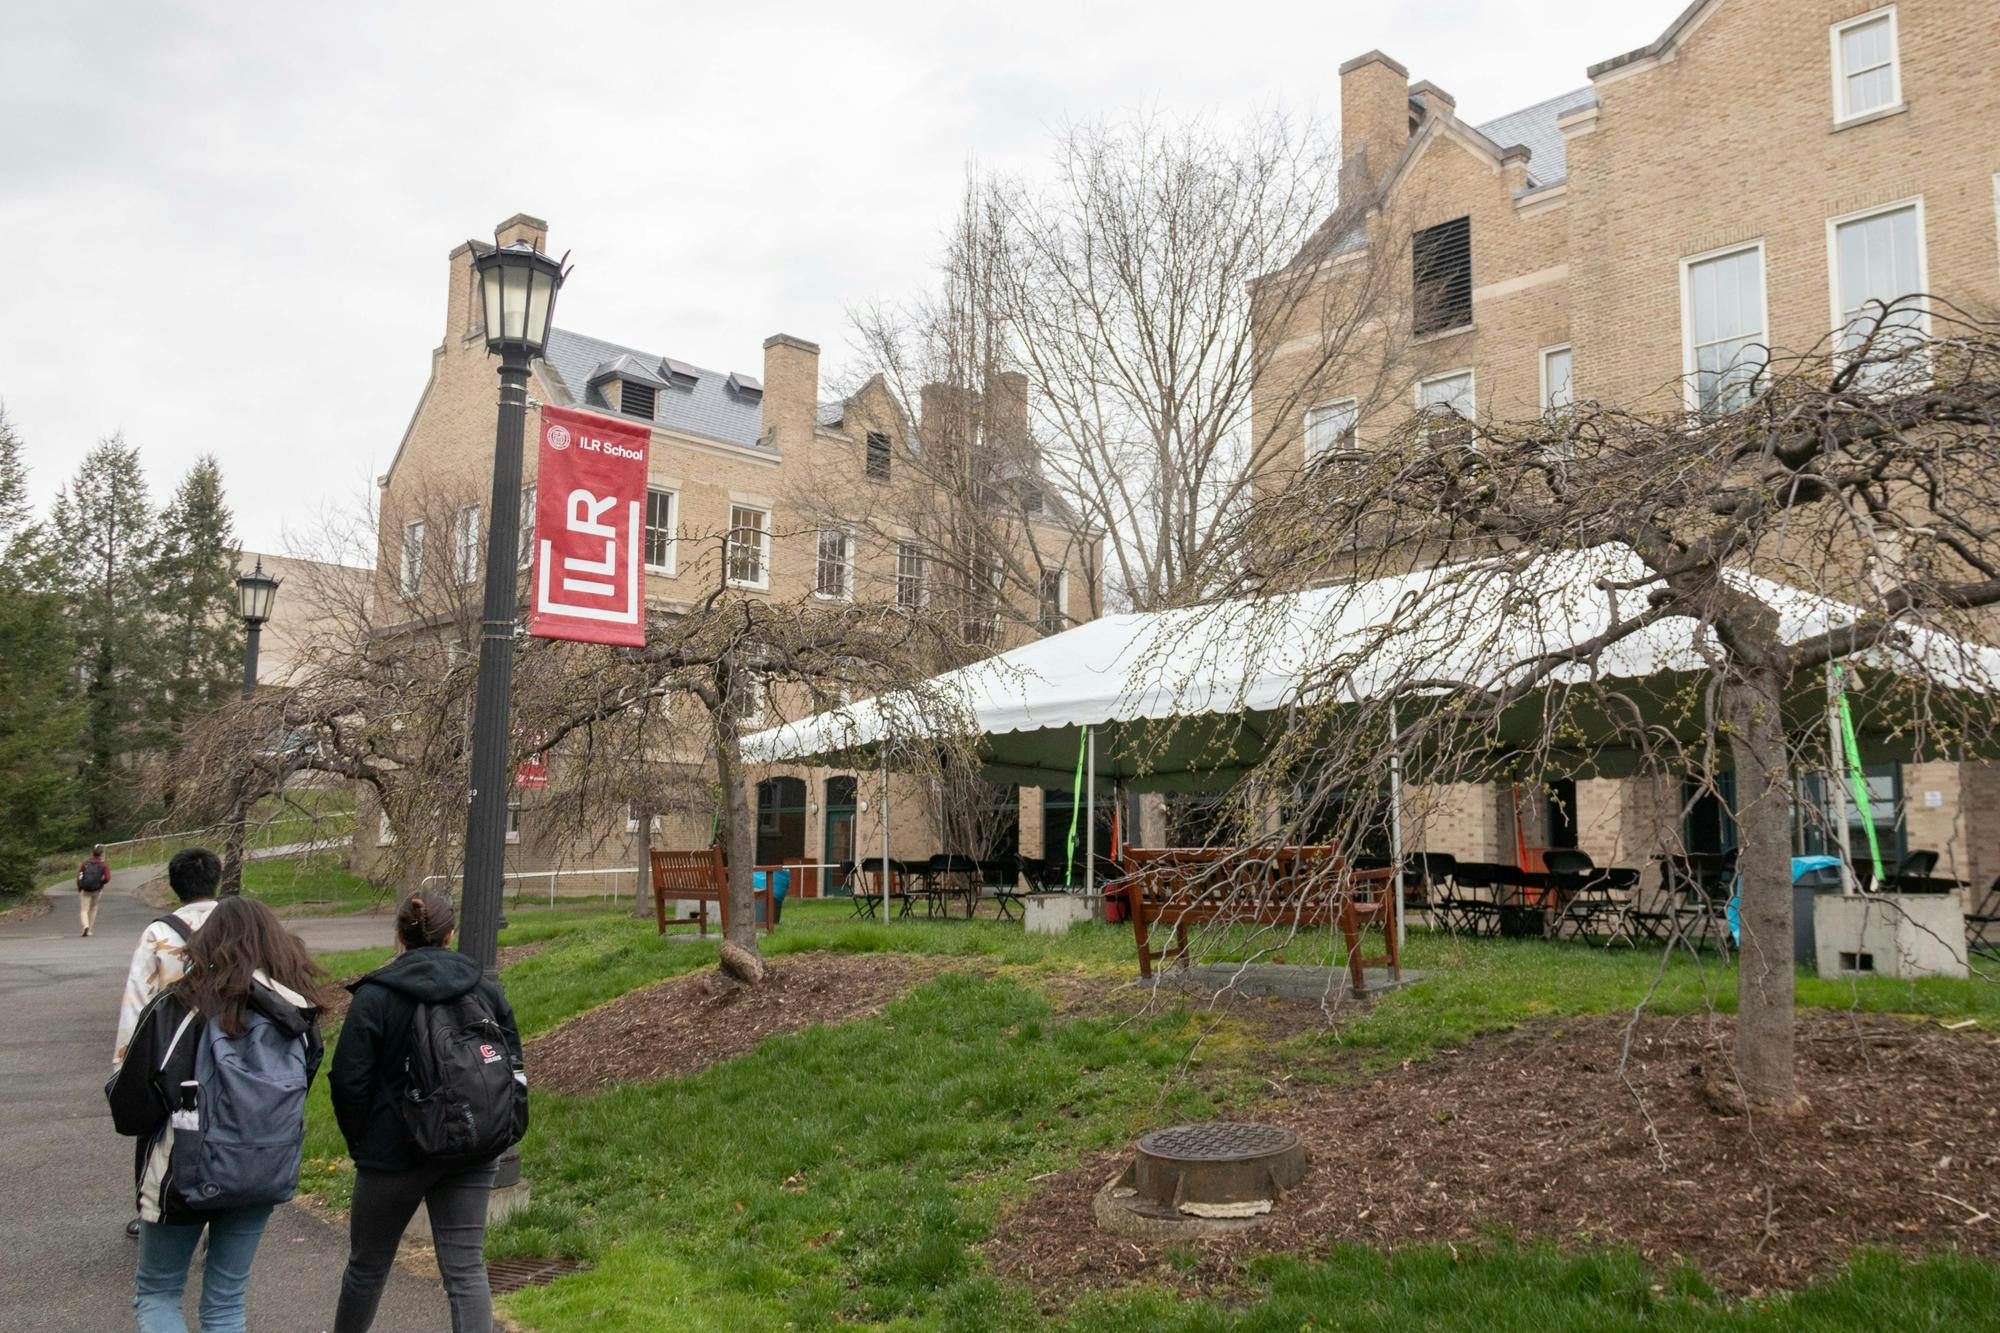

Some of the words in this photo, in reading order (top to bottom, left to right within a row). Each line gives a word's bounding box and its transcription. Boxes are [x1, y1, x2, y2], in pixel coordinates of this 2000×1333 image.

[580, 436, 601, 452] ILR
[603, 442, 643, 461] School
[564, 489, 617, 596] ILR
[480, 1045, 496, 1058] C
